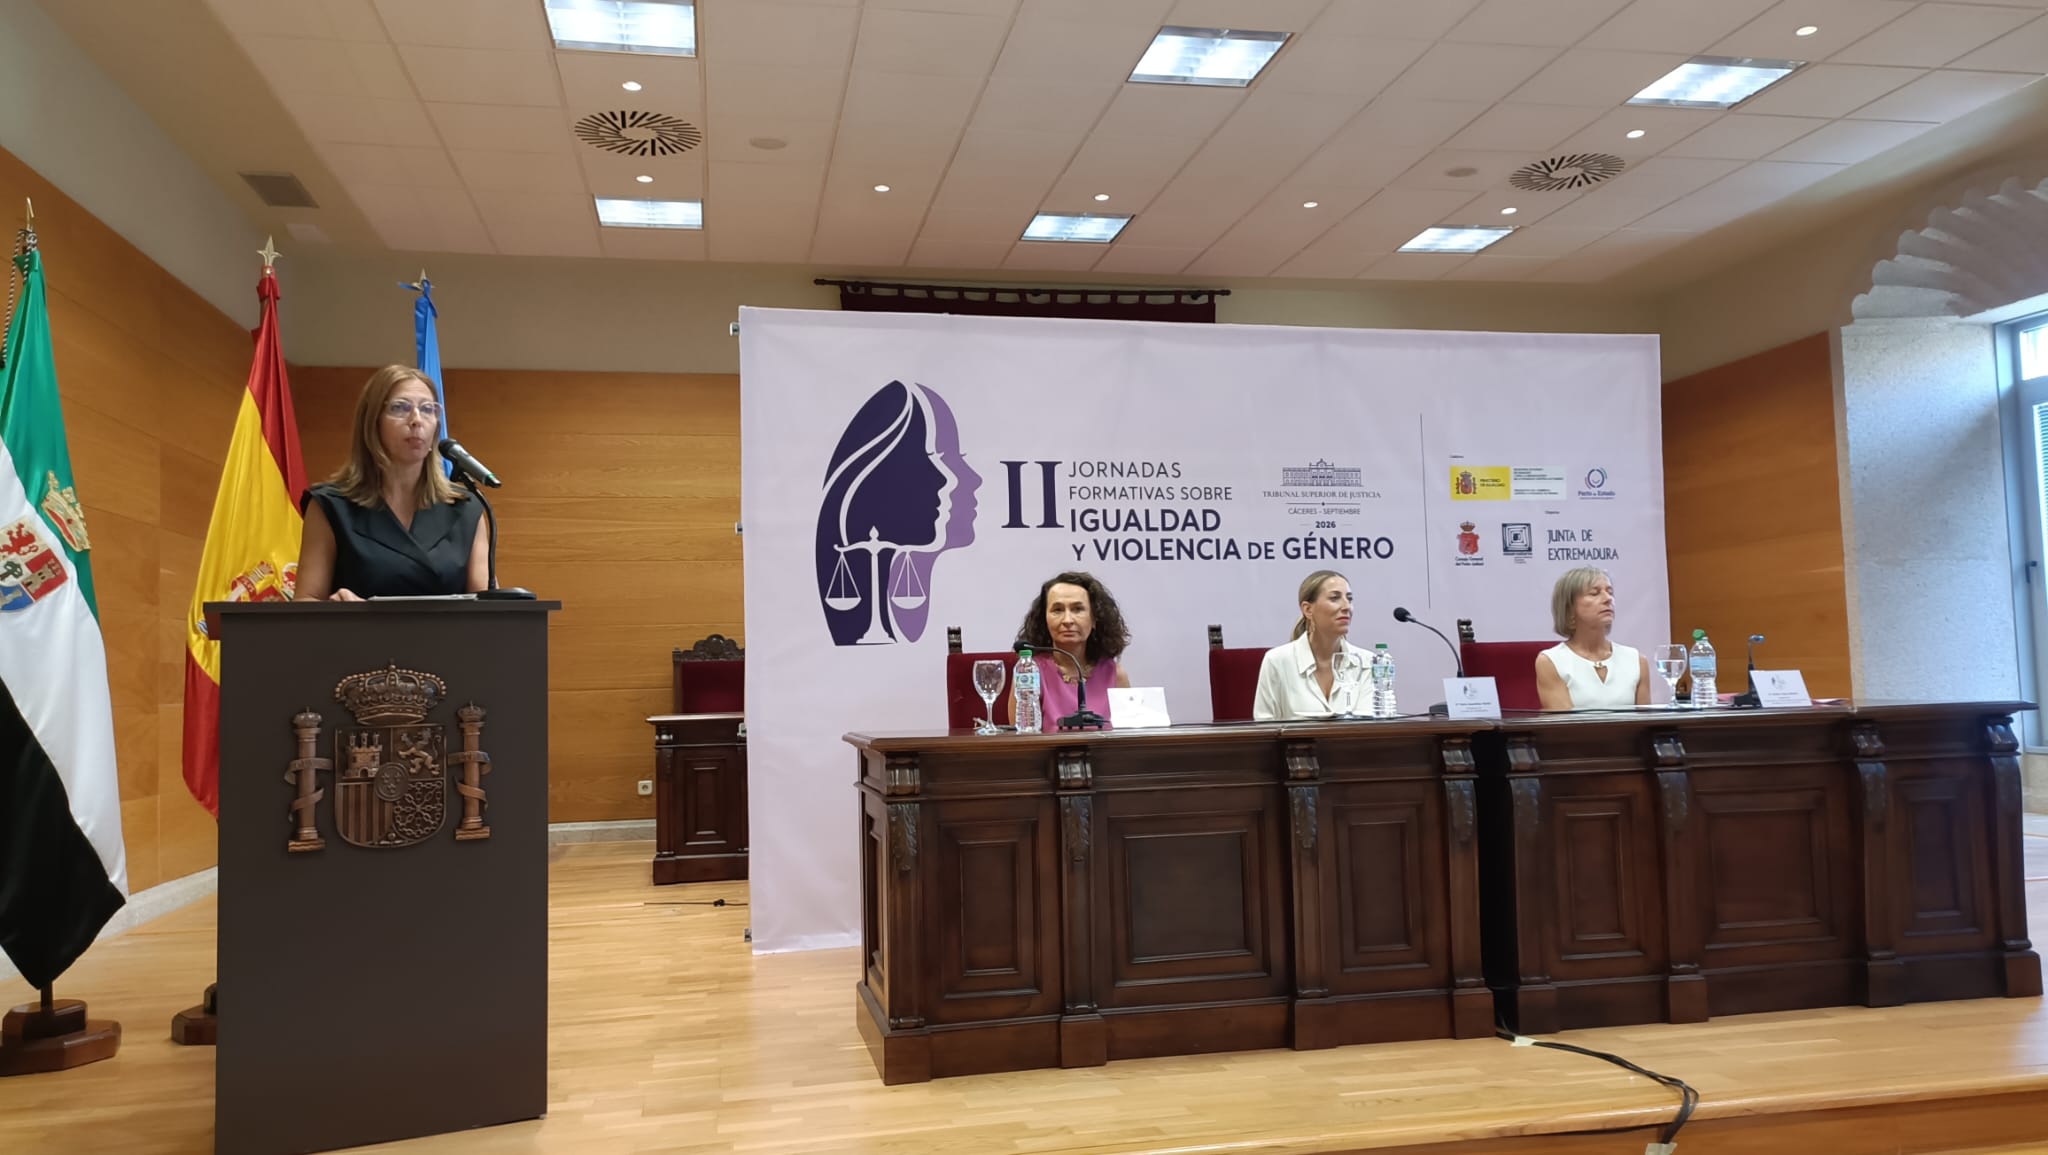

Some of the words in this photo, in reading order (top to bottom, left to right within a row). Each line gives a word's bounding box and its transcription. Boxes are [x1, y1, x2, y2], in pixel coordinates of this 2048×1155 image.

[1068, 461, 1182, 478] JORNADAS
[1000, 461, 1065, 528] II
[1069, 486, 1175, 500] FORMATIVAS
[1181, 486, 1233, 501] SOBRE
[1349, 491, 1381, 499] JUSTICIA
[1288, 507, 1318, 515] CÁCERES
[1071, 508, 1221, 532] IGUALDAD
[1547, 529, 1577, 544] JUNTA
[1581, 529, 1593, 542] DE
[1072, 543, 1086, 561] Y
[1093, 538, 1241, 561] VIOLENCIA
[1248, 542, 1275, 560] DE
[1282, 531, 1394, 560] GÉNERO
[1548, 548, 1619, 560] EXTREMADURA
